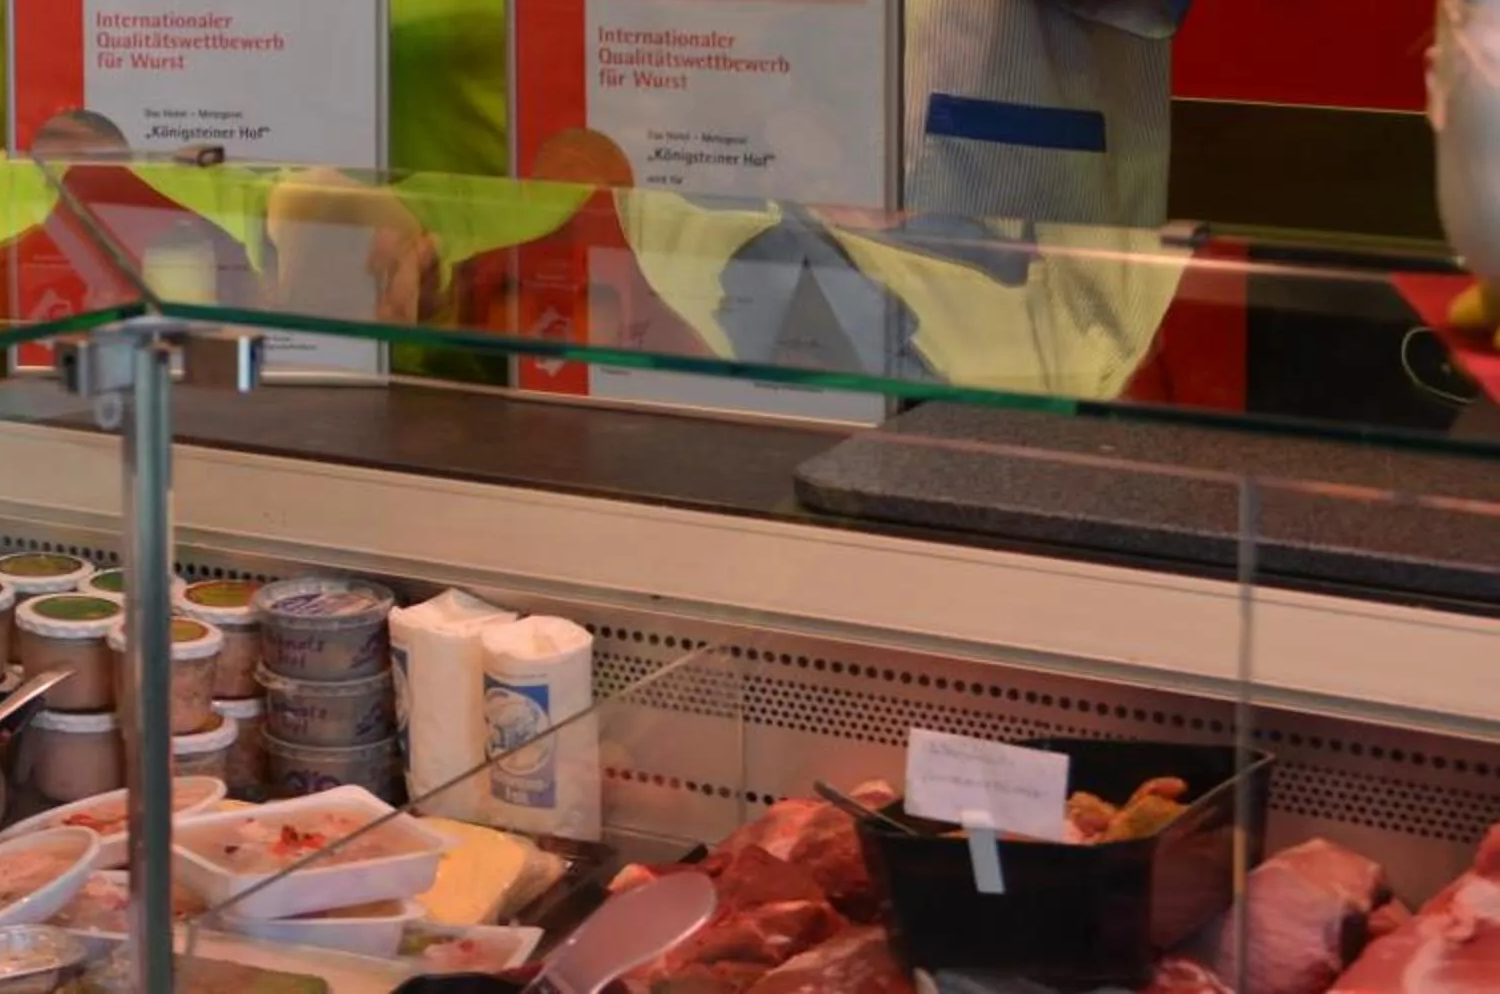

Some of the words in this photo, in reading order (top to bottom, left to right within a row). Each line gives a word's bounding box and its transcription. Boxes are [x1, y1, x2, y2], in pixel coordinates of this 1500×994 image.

[95, 10, 234, 29] Internationaler
[95, 30, 287, 51] Qualitätswettbewerb
[598, 26, 737, 49] Internationaler
[96, 52, 124, 70] für
[130, 52, 186, 70] Wurst
[598, 47, 792, 75] Qualitätswettbewerb
[599, 68, 626, 87] für
[633, 70, 689, 90] Wurst
